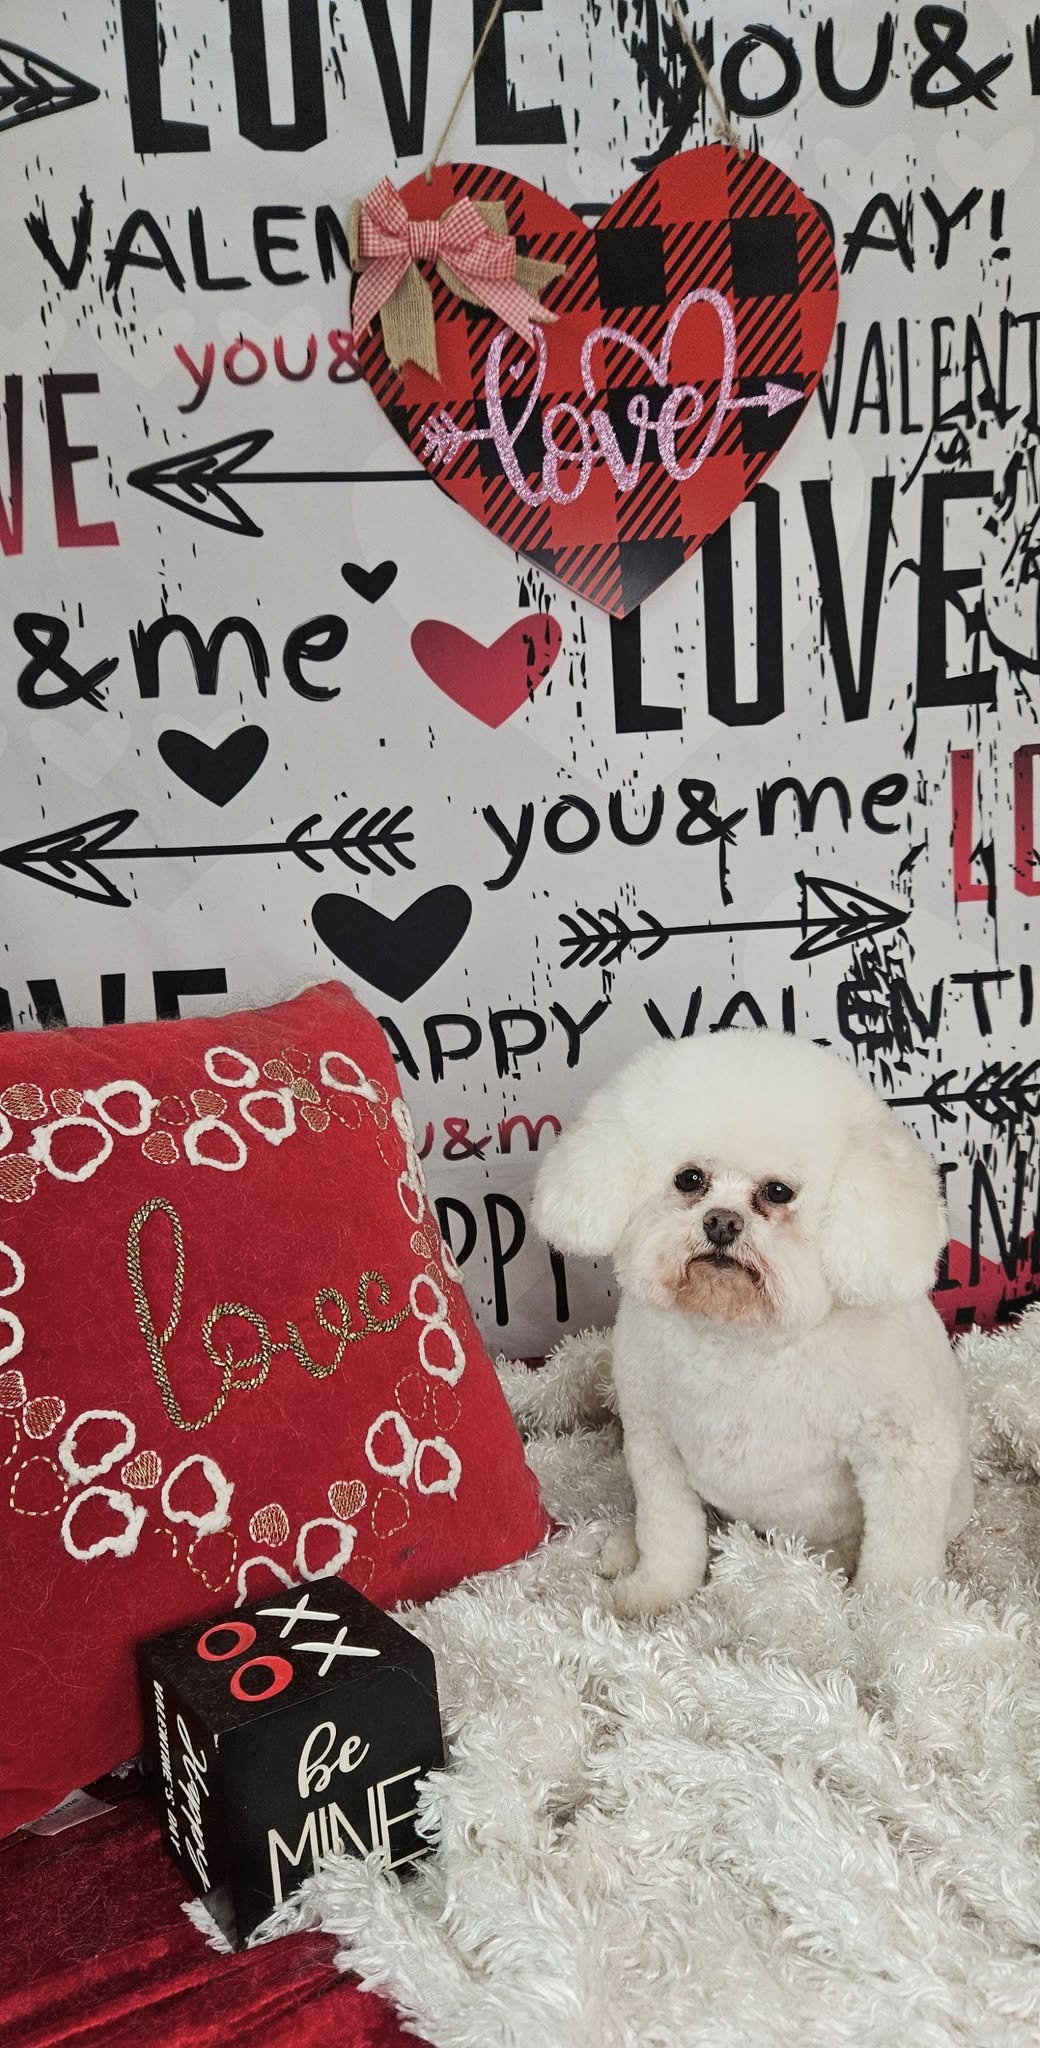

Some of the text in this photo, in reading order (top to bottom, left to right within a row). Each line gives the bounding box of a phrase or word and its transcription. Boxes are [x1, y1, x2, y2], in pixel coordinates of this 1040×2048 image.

[807, 187, 1010, 274] AY!
[485, 288, 738, 506] love
[609, 471, 998, 734] LOVE
[127, 1197, 411, 1432] love
[268, 1765, 429, 1903] MINE
[297, 1721, 370, 1799] be
